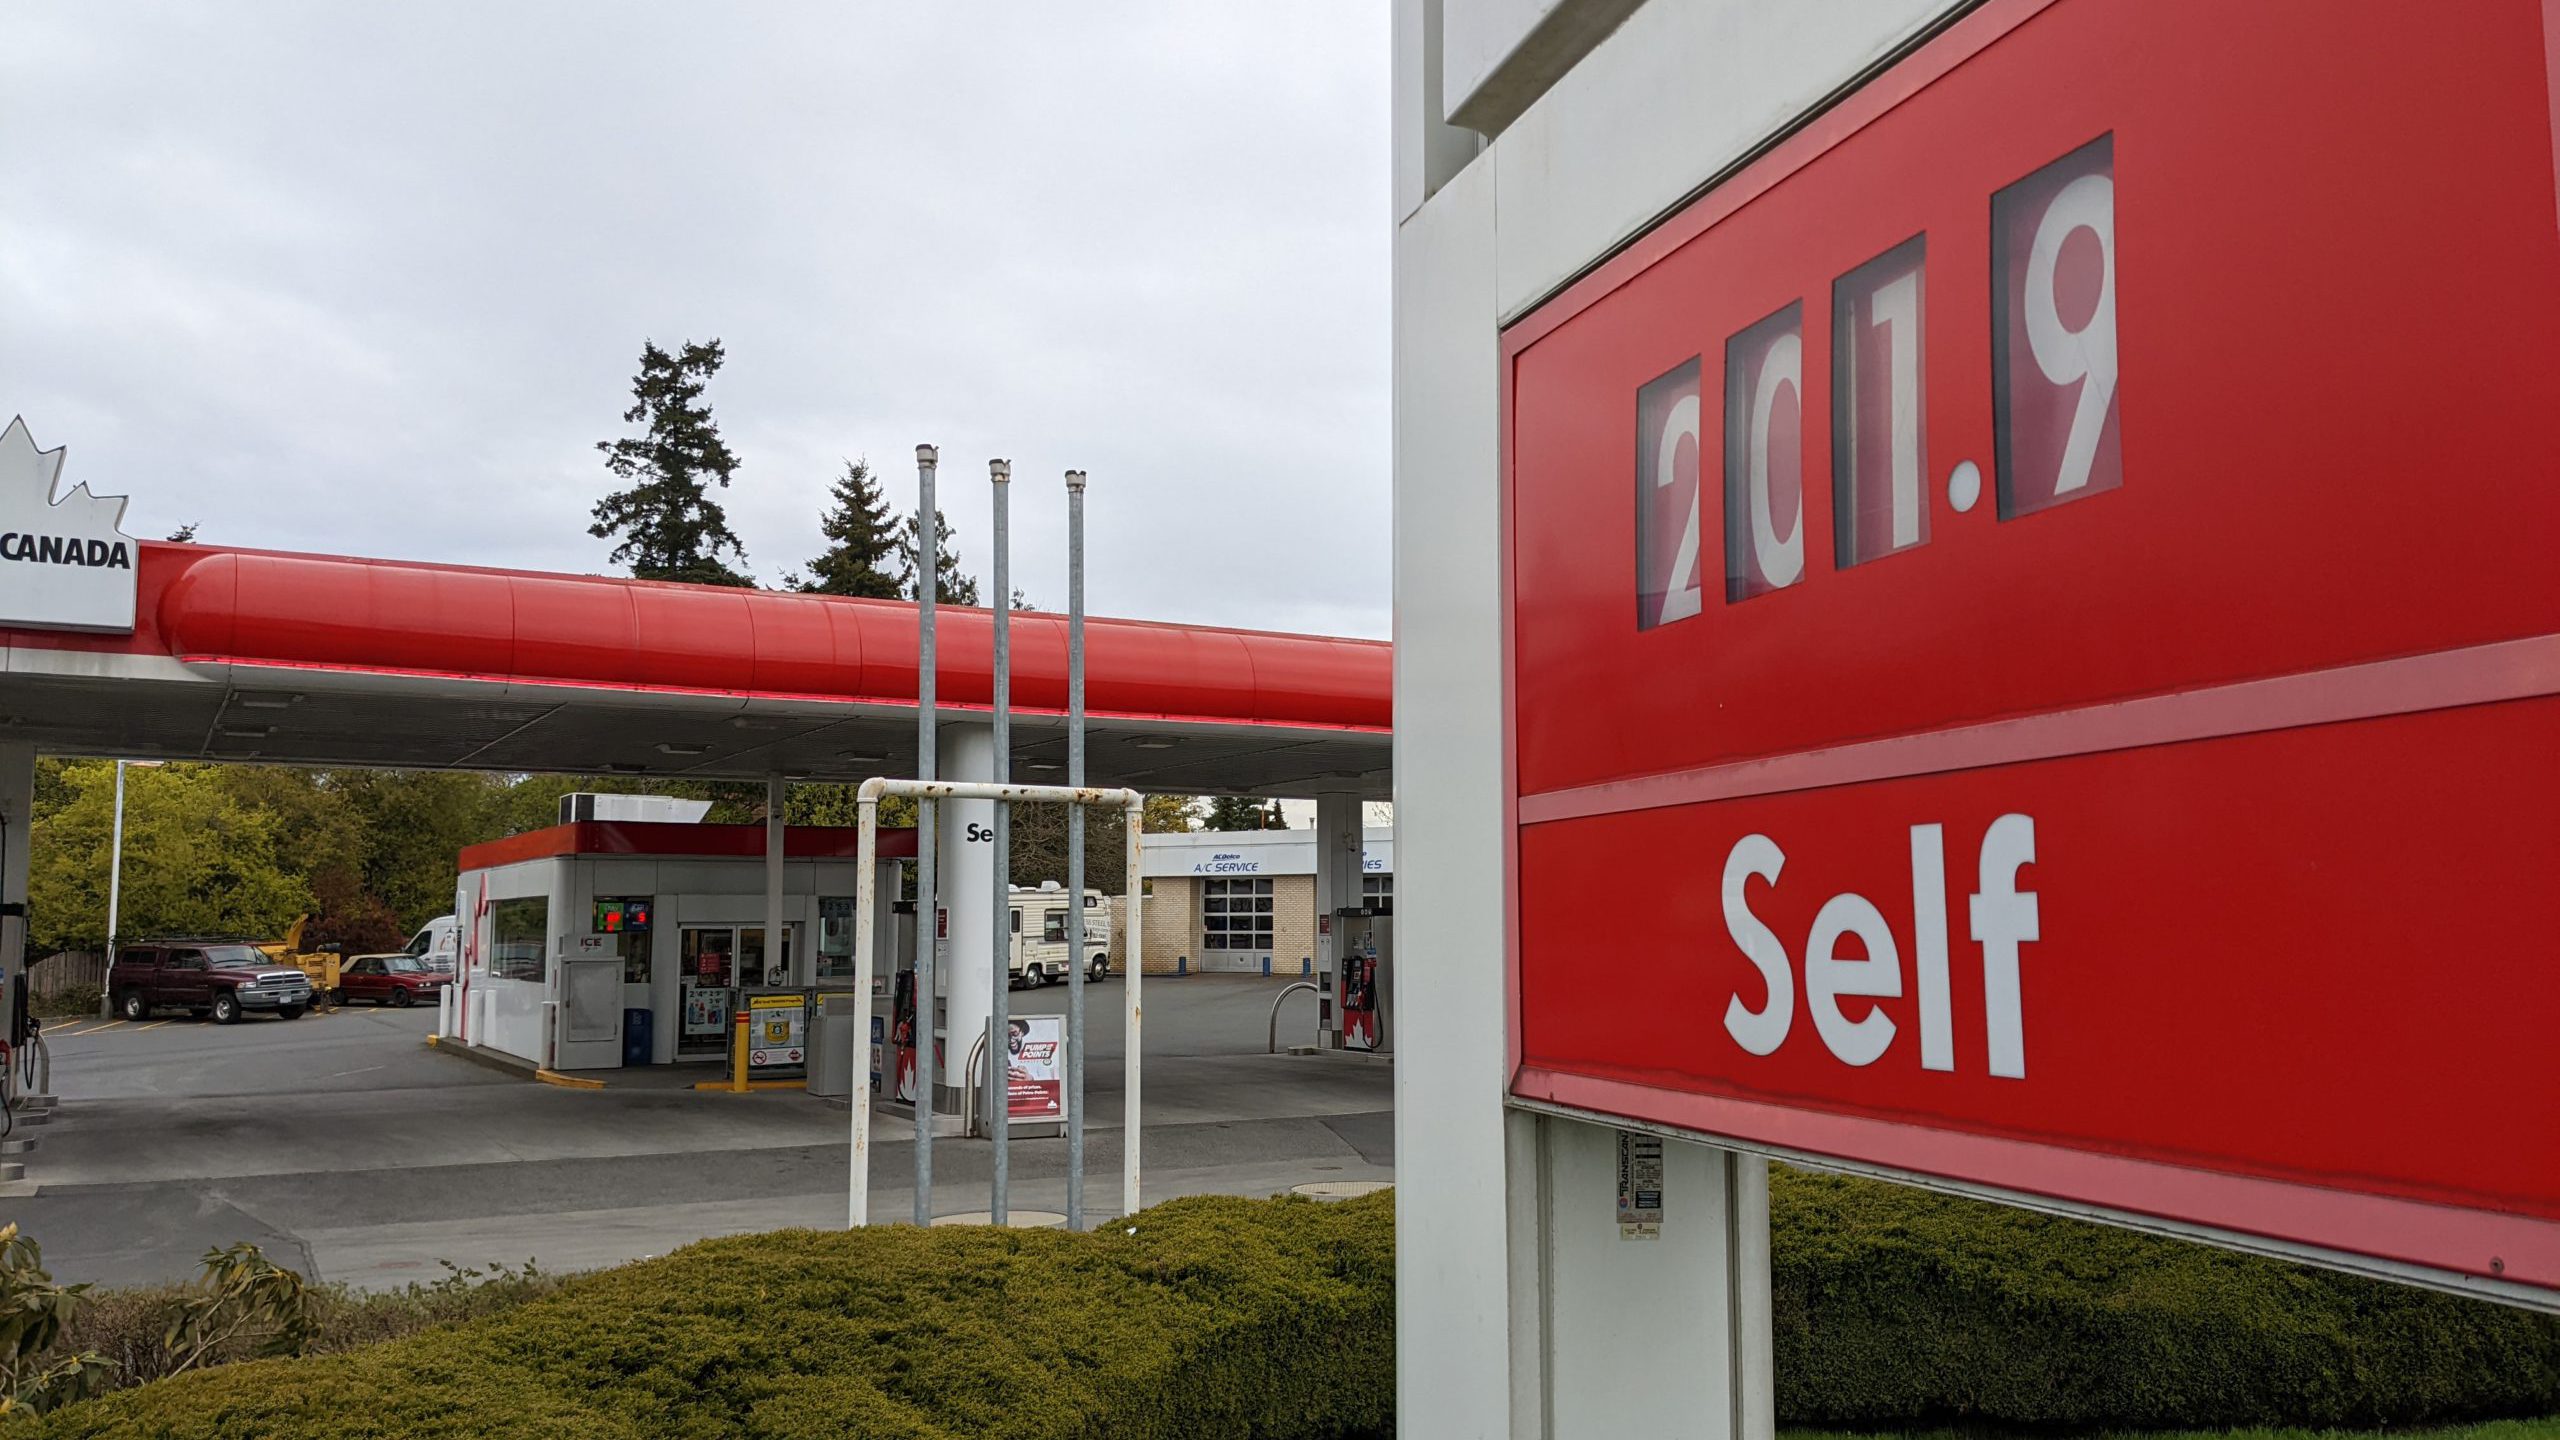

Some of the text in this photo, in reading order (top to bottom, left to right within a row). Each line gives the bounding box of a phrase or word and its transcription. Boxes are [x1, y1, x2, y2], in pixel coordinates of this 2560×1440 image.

[1657, 173, 2118, 626] 201.9
[0, 532, 131, 569] CANADA
[967, 822, 993, 843] Se
[1193, 862, 1259, 873] A/C SERVICE
[580, 937, 602, 947] ICE
[1721, 813, 2040, 1080] Self
